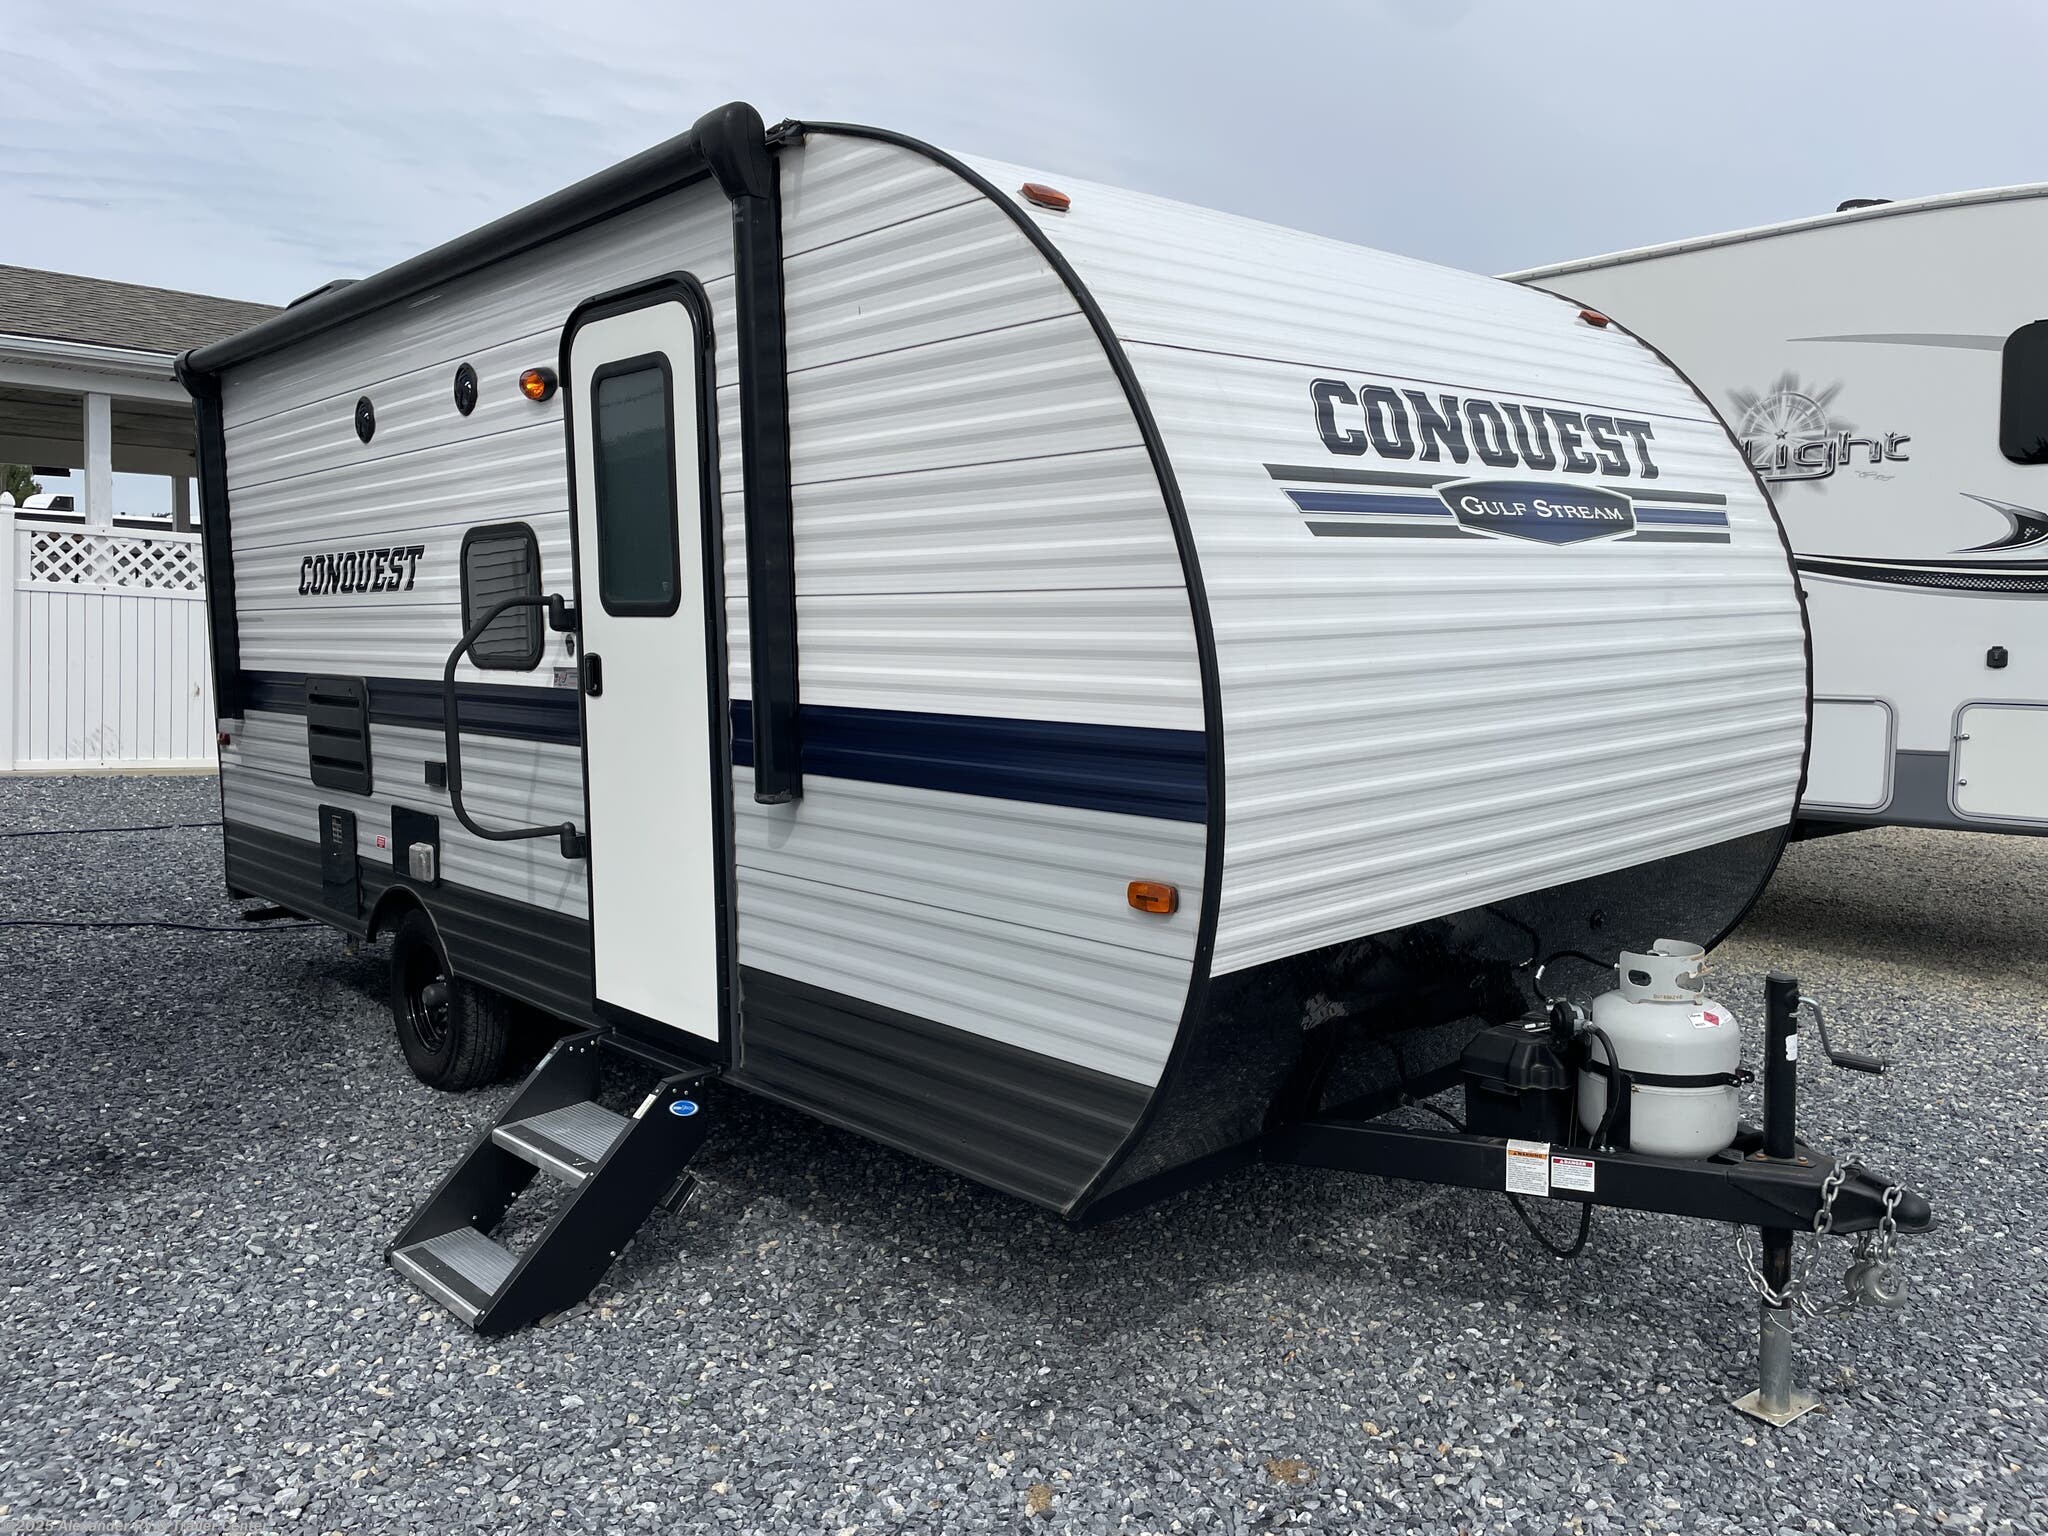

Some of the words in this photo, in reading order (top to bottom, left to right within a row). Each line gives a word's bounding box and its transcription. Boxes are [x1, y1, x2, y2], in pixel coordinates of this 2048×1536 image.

[1309, 378, 1660, 479] CONQUEST
[1460, 495, 1527, 516] GULF
[1532, 499, 1624, 520] STREAM
[299, 544, 425, 595] CONQUEST
